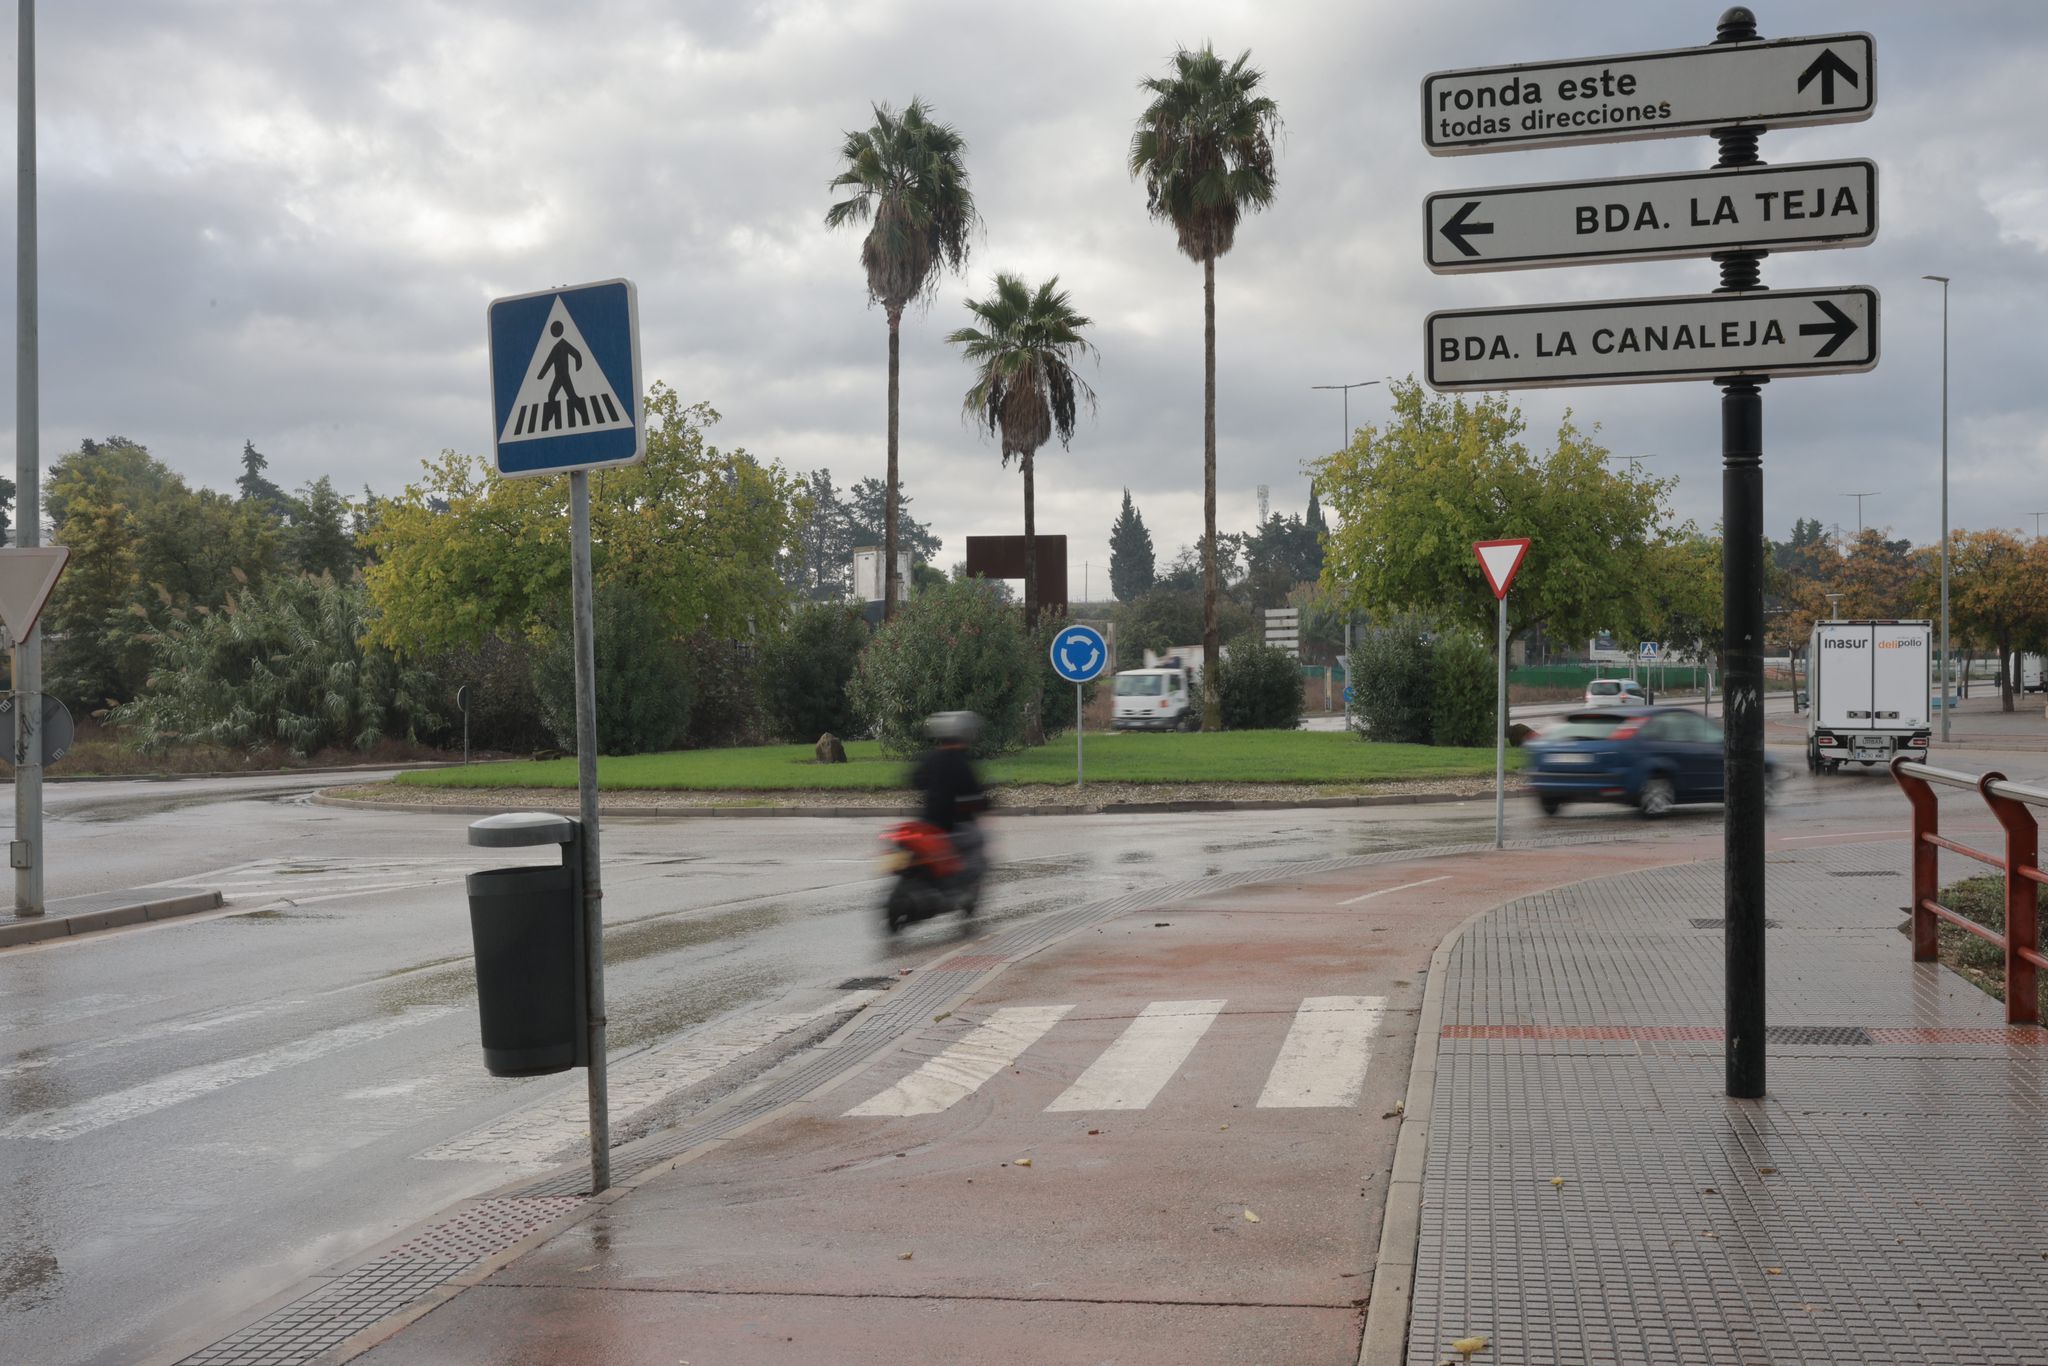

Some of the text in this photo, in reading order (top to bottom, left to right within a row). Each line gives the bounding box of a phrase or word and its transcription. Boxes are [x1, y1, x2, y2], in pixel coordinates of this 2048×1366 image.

[1439, 69, 1637, 112] ronda este
[1440, 102, 1672, 138] todas direcciones
[1576, 187, 1859, 235] BDA. LA TEJA
[1440, 319, 1786, 363] BDA. LA CANALEJA
